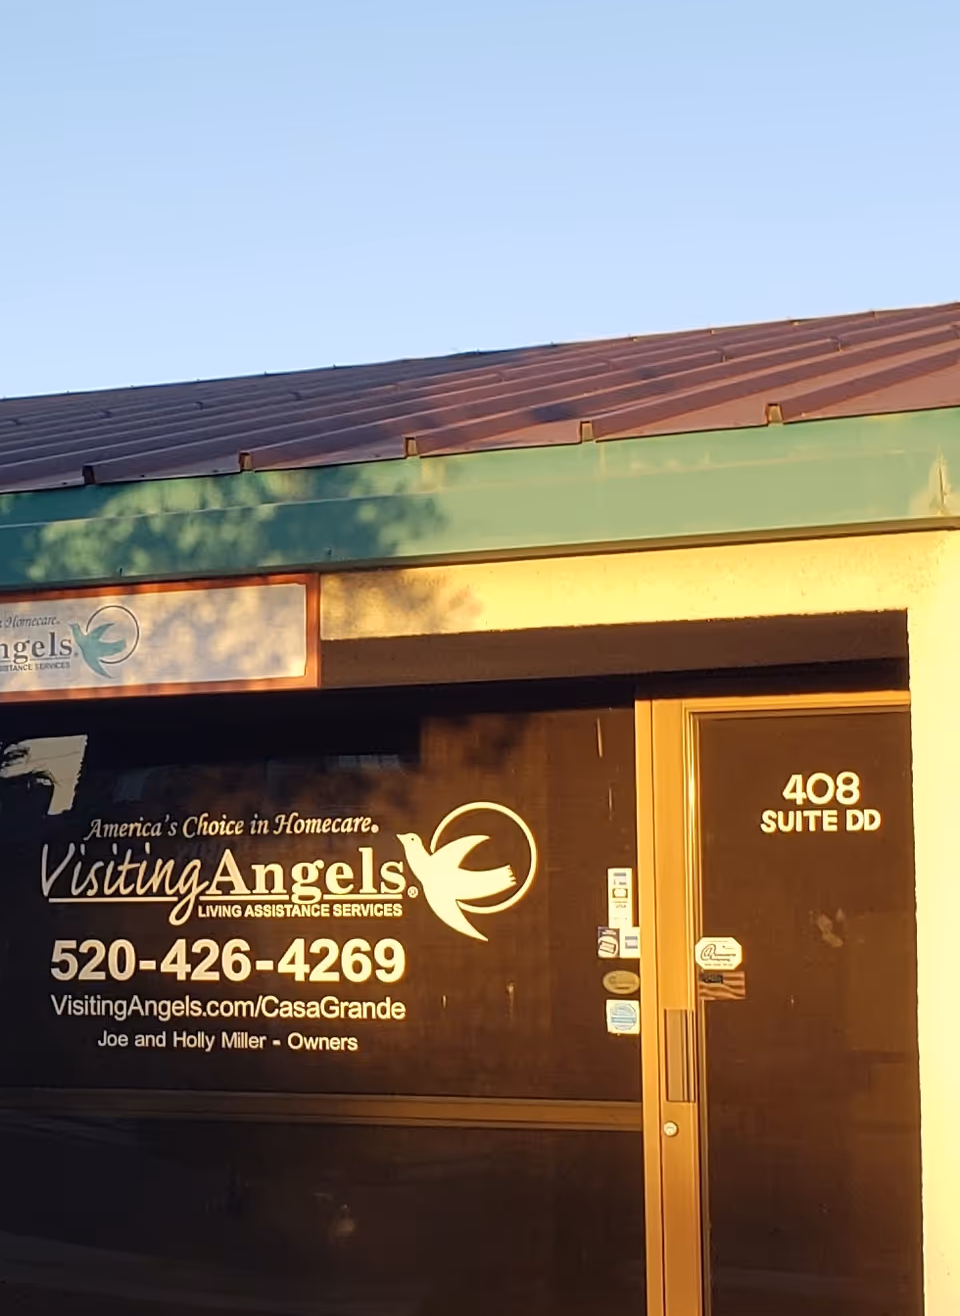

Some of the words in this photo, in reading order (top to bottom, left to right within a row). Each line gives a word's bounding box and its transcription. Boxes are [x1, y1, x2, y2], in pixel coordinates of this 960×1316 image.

[35, 660, 71, 671] SERVICES
[782, 771, 862, 806] 408
[83, 814, 178, 841] America's
[182, 812, 245, 838] Choice
[249, 813, 270, 834] in
[760, 809, 839, 834] SUITE
[845, 809, 882, 832] DD
[197, 904, 243, 919] LIVING
[244, 904, 330, 918] ASSISTANCE
[332, 903, 404, 918] SERVICES
[50, 937, 407, 983] 520-426-4269
[50, 994, 407, 1023] VisitingAngels.com/CasaGrande
[97, 1030, 129, 1047] Joe
[134, 1031, 167, 1048] and
[172, 1030, 216, 1053] Holly
[221, 1031, 267, 1050] Miller
[287, 1032, 359, 1052] Owners
